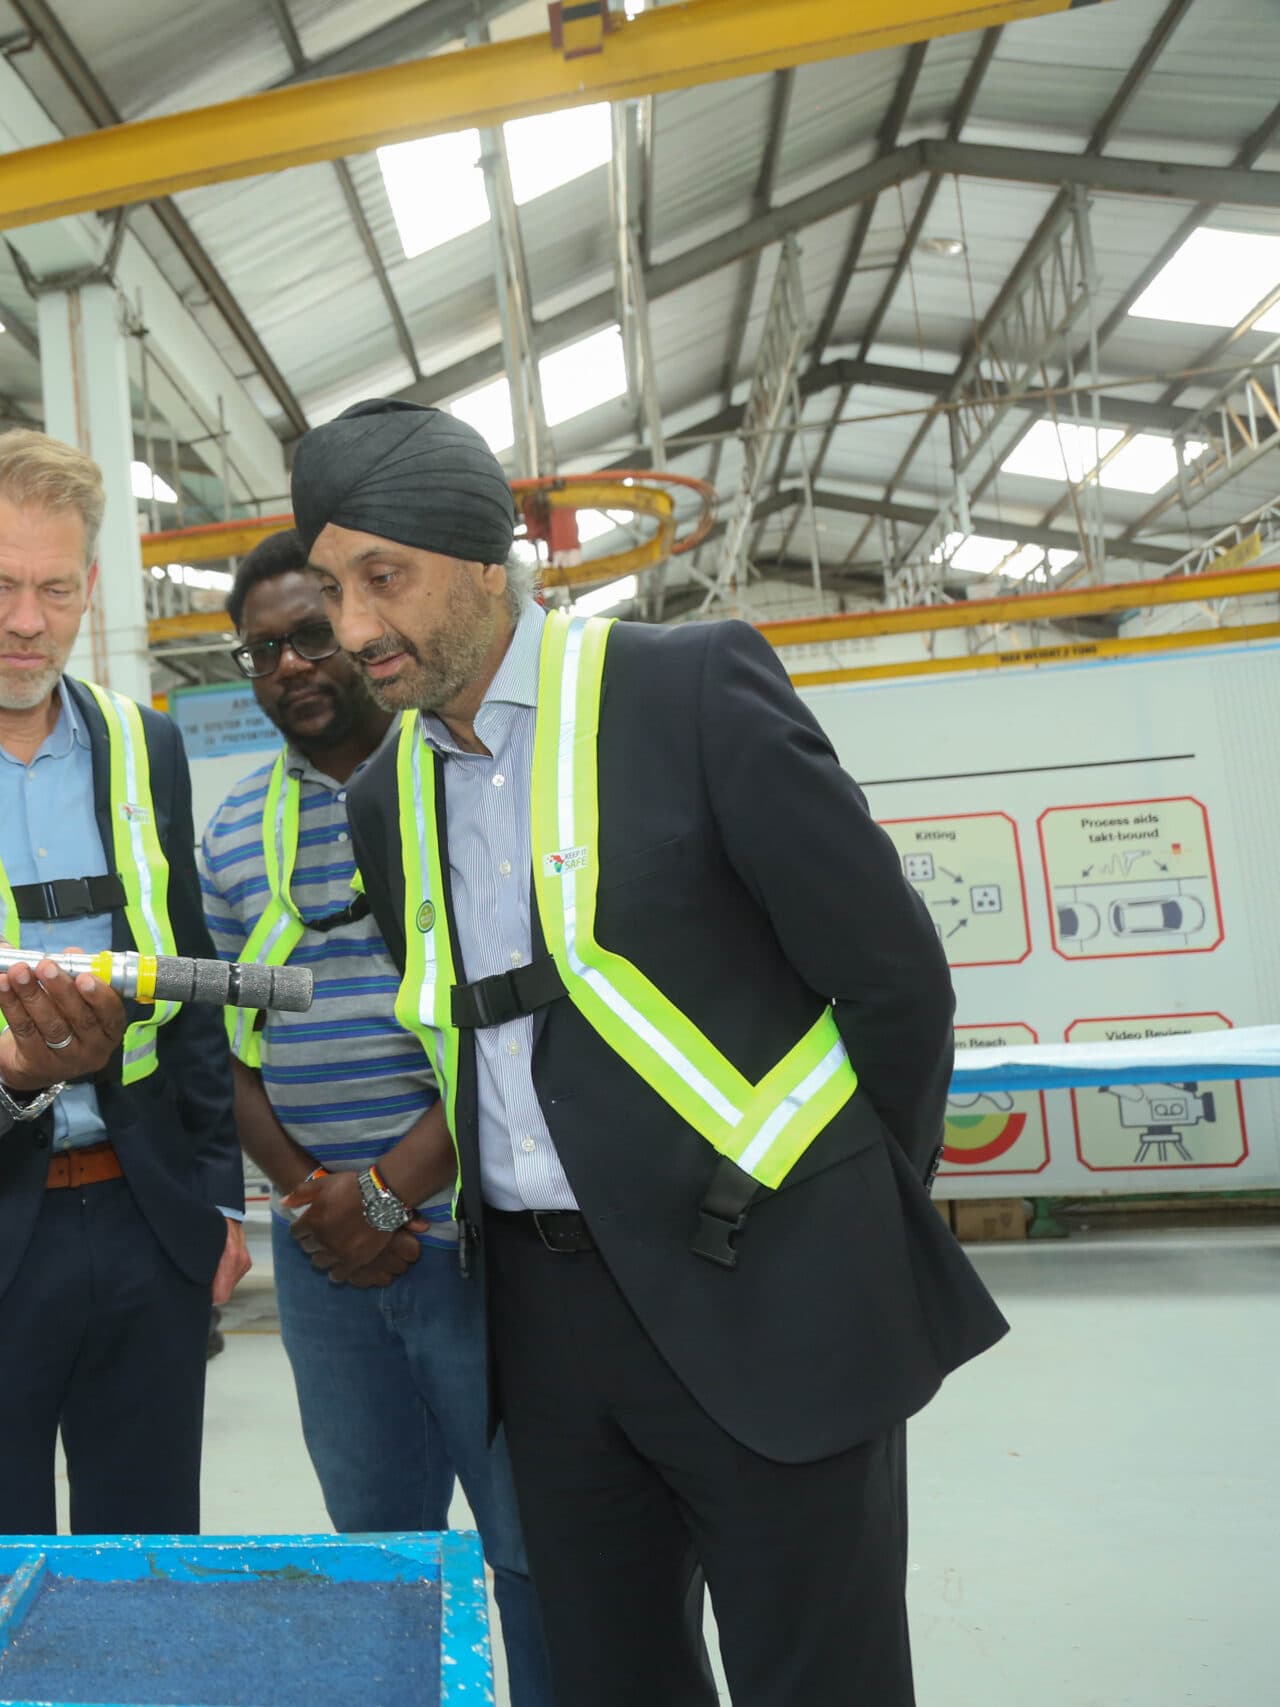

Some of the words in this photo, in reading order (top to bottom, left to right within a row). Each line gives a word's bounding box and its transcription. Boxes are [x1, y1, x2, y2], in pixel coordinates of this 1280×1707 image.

[1081, 817, 1129, 829] Process
[1133, 813, 1159, 824] aids
[915, 830, 957, 842] Kitting
[1088, 828, 1159, 843] takt-bound
[565, 856, 586, 870] SAFE
[1104, 1030, 1142, 1041] Video
[969, 1037, 1007, 1048] Reach
